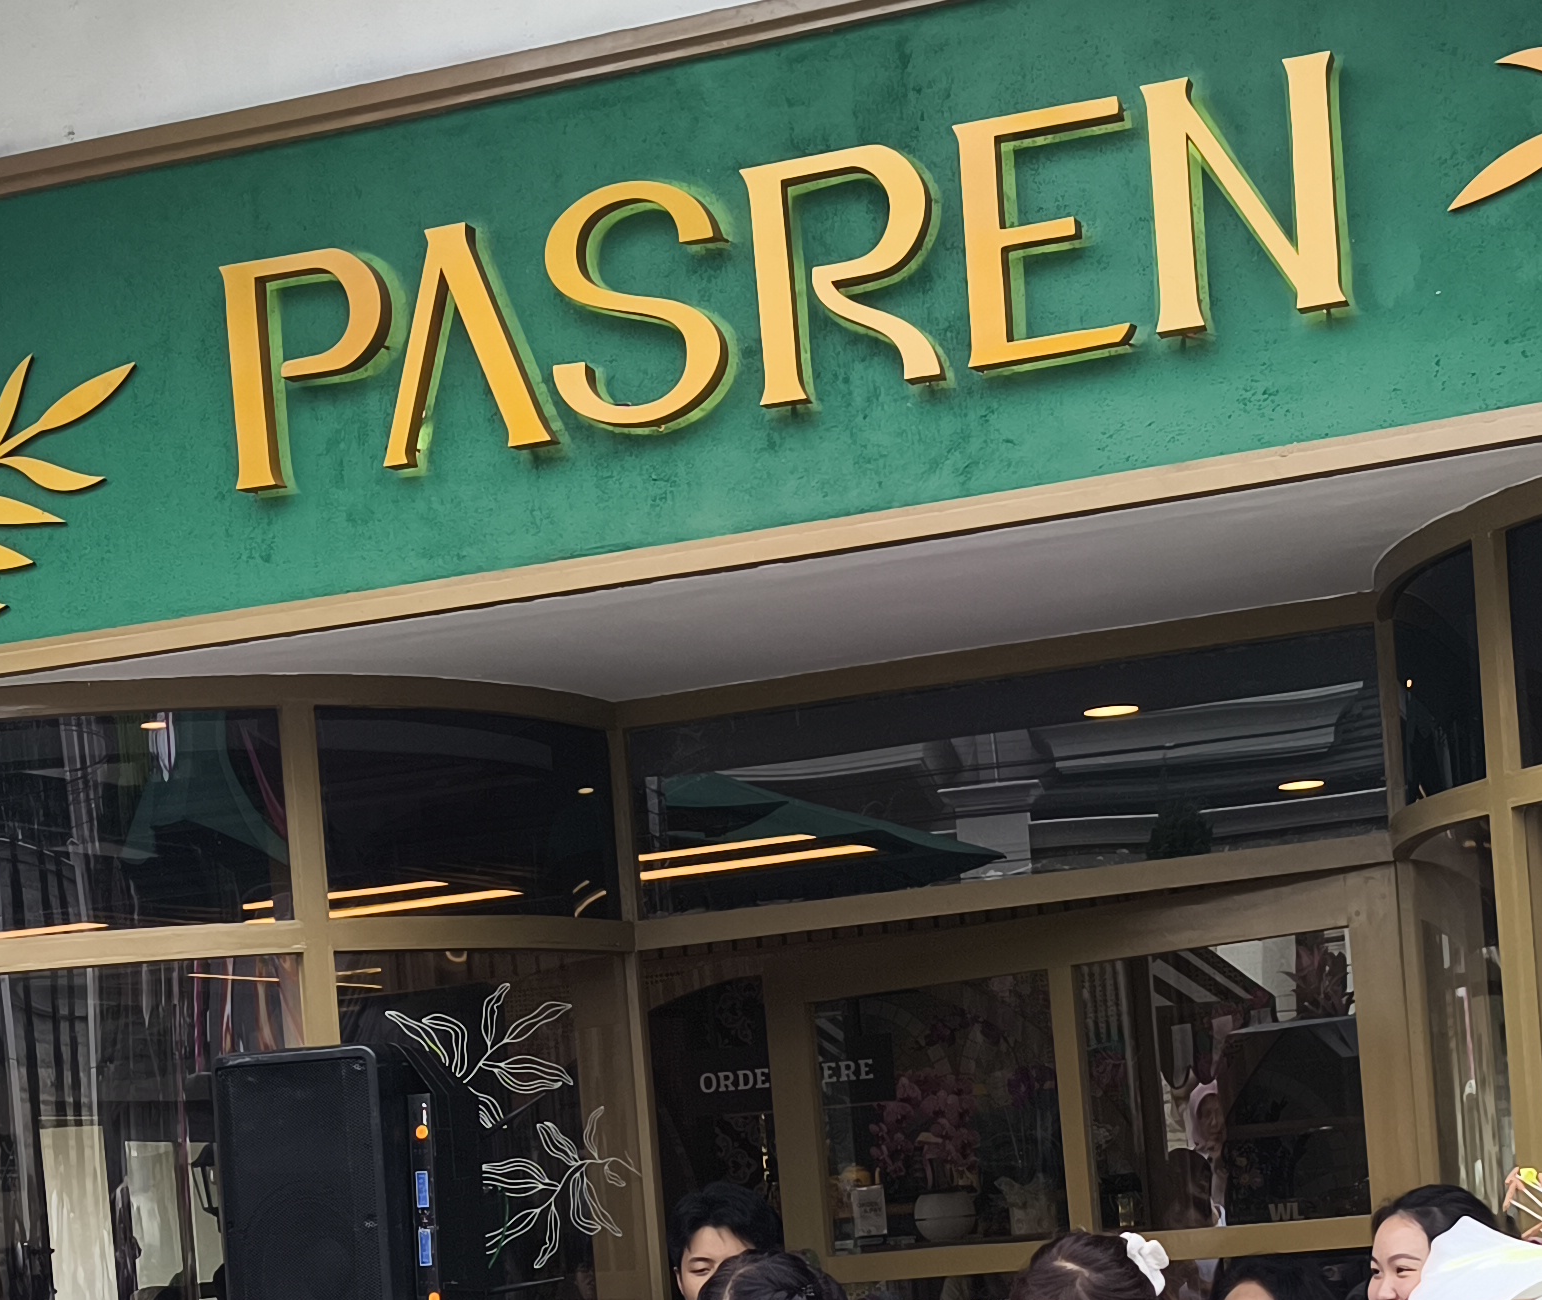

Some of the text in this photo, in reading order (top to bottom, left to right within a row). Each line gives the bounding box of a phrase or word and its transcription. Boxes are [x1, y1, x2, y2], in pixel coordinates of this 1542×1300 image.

[219, 50, 1349, 494] PASREN
[699, 1058, 874, 1093] ORDE ERE
